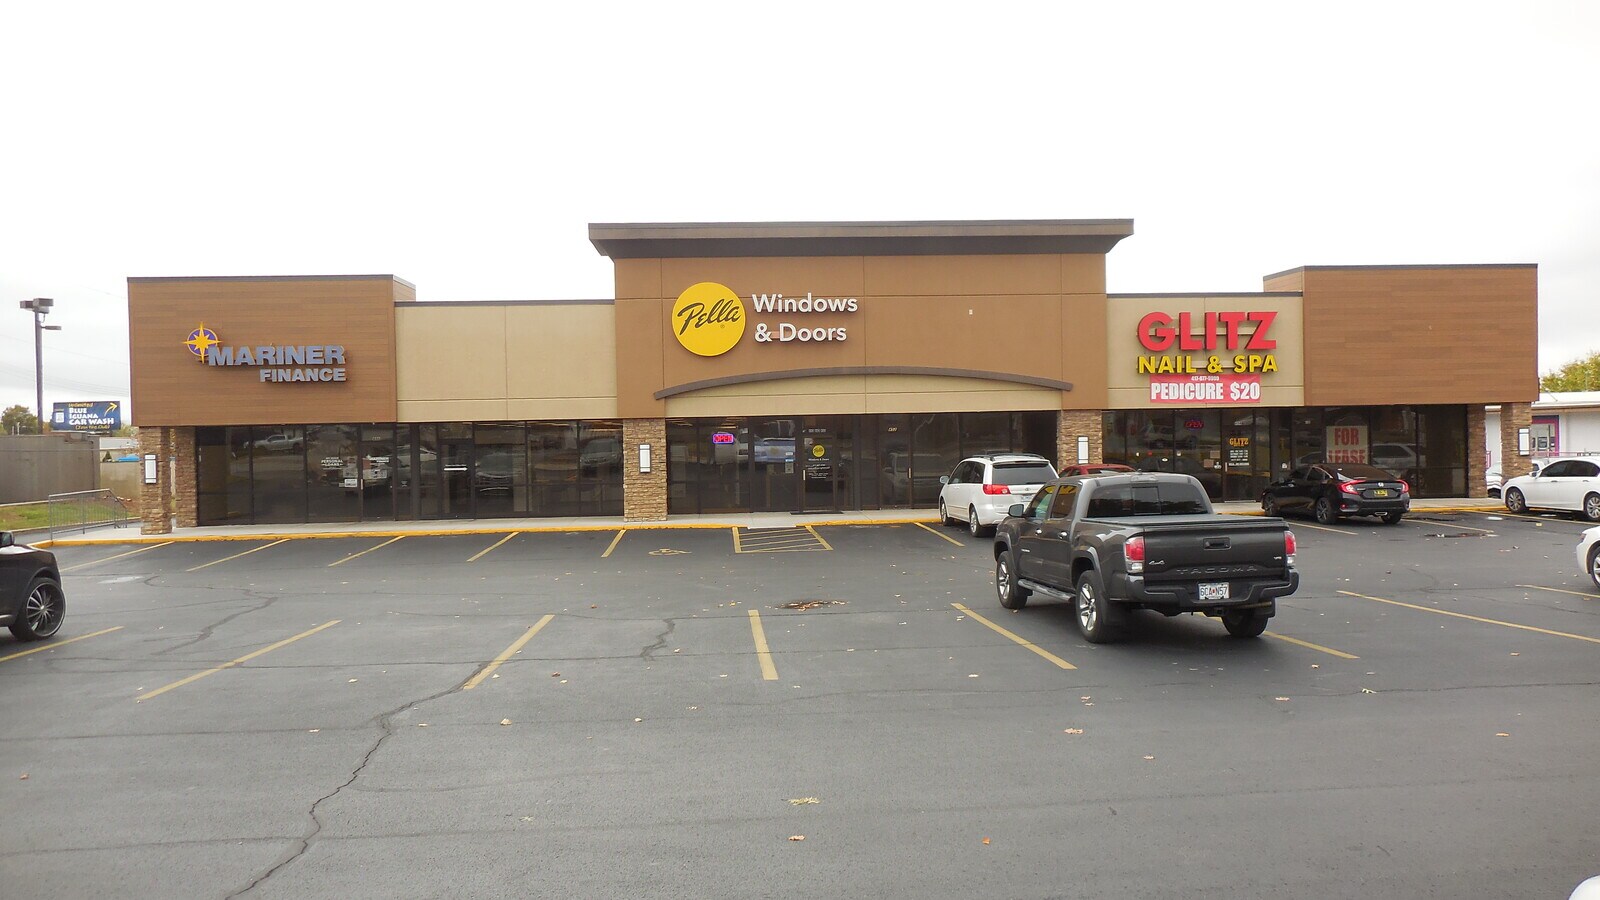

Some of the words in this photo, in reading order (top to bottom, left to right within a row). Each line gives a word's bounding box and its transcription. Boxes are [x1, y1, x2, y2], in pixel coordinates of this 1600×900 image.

[752, 293, 858, 313] Windows
[677, 299, 741, 336] Pella
[755, 323, 773, 342] &
[779, 323, 847, 341] Doors
[1137, 311, 1279, 352] GLITZ
[208, 345, 346, 366] MARINER
[1138, 355, 1197, 374] NAIL
[1206, 355, 1223, 374] &
[1233, 354, 1278, 373] SPA
[260, 368, 346, 382] FINANCE
[1151, 382, 1224, 400] PEDICURE
[1230, 382, 1260, 401] $20
[1334, 427, 1360, 446] FOR
[1176, 565, 1258, 575] TACOMA
